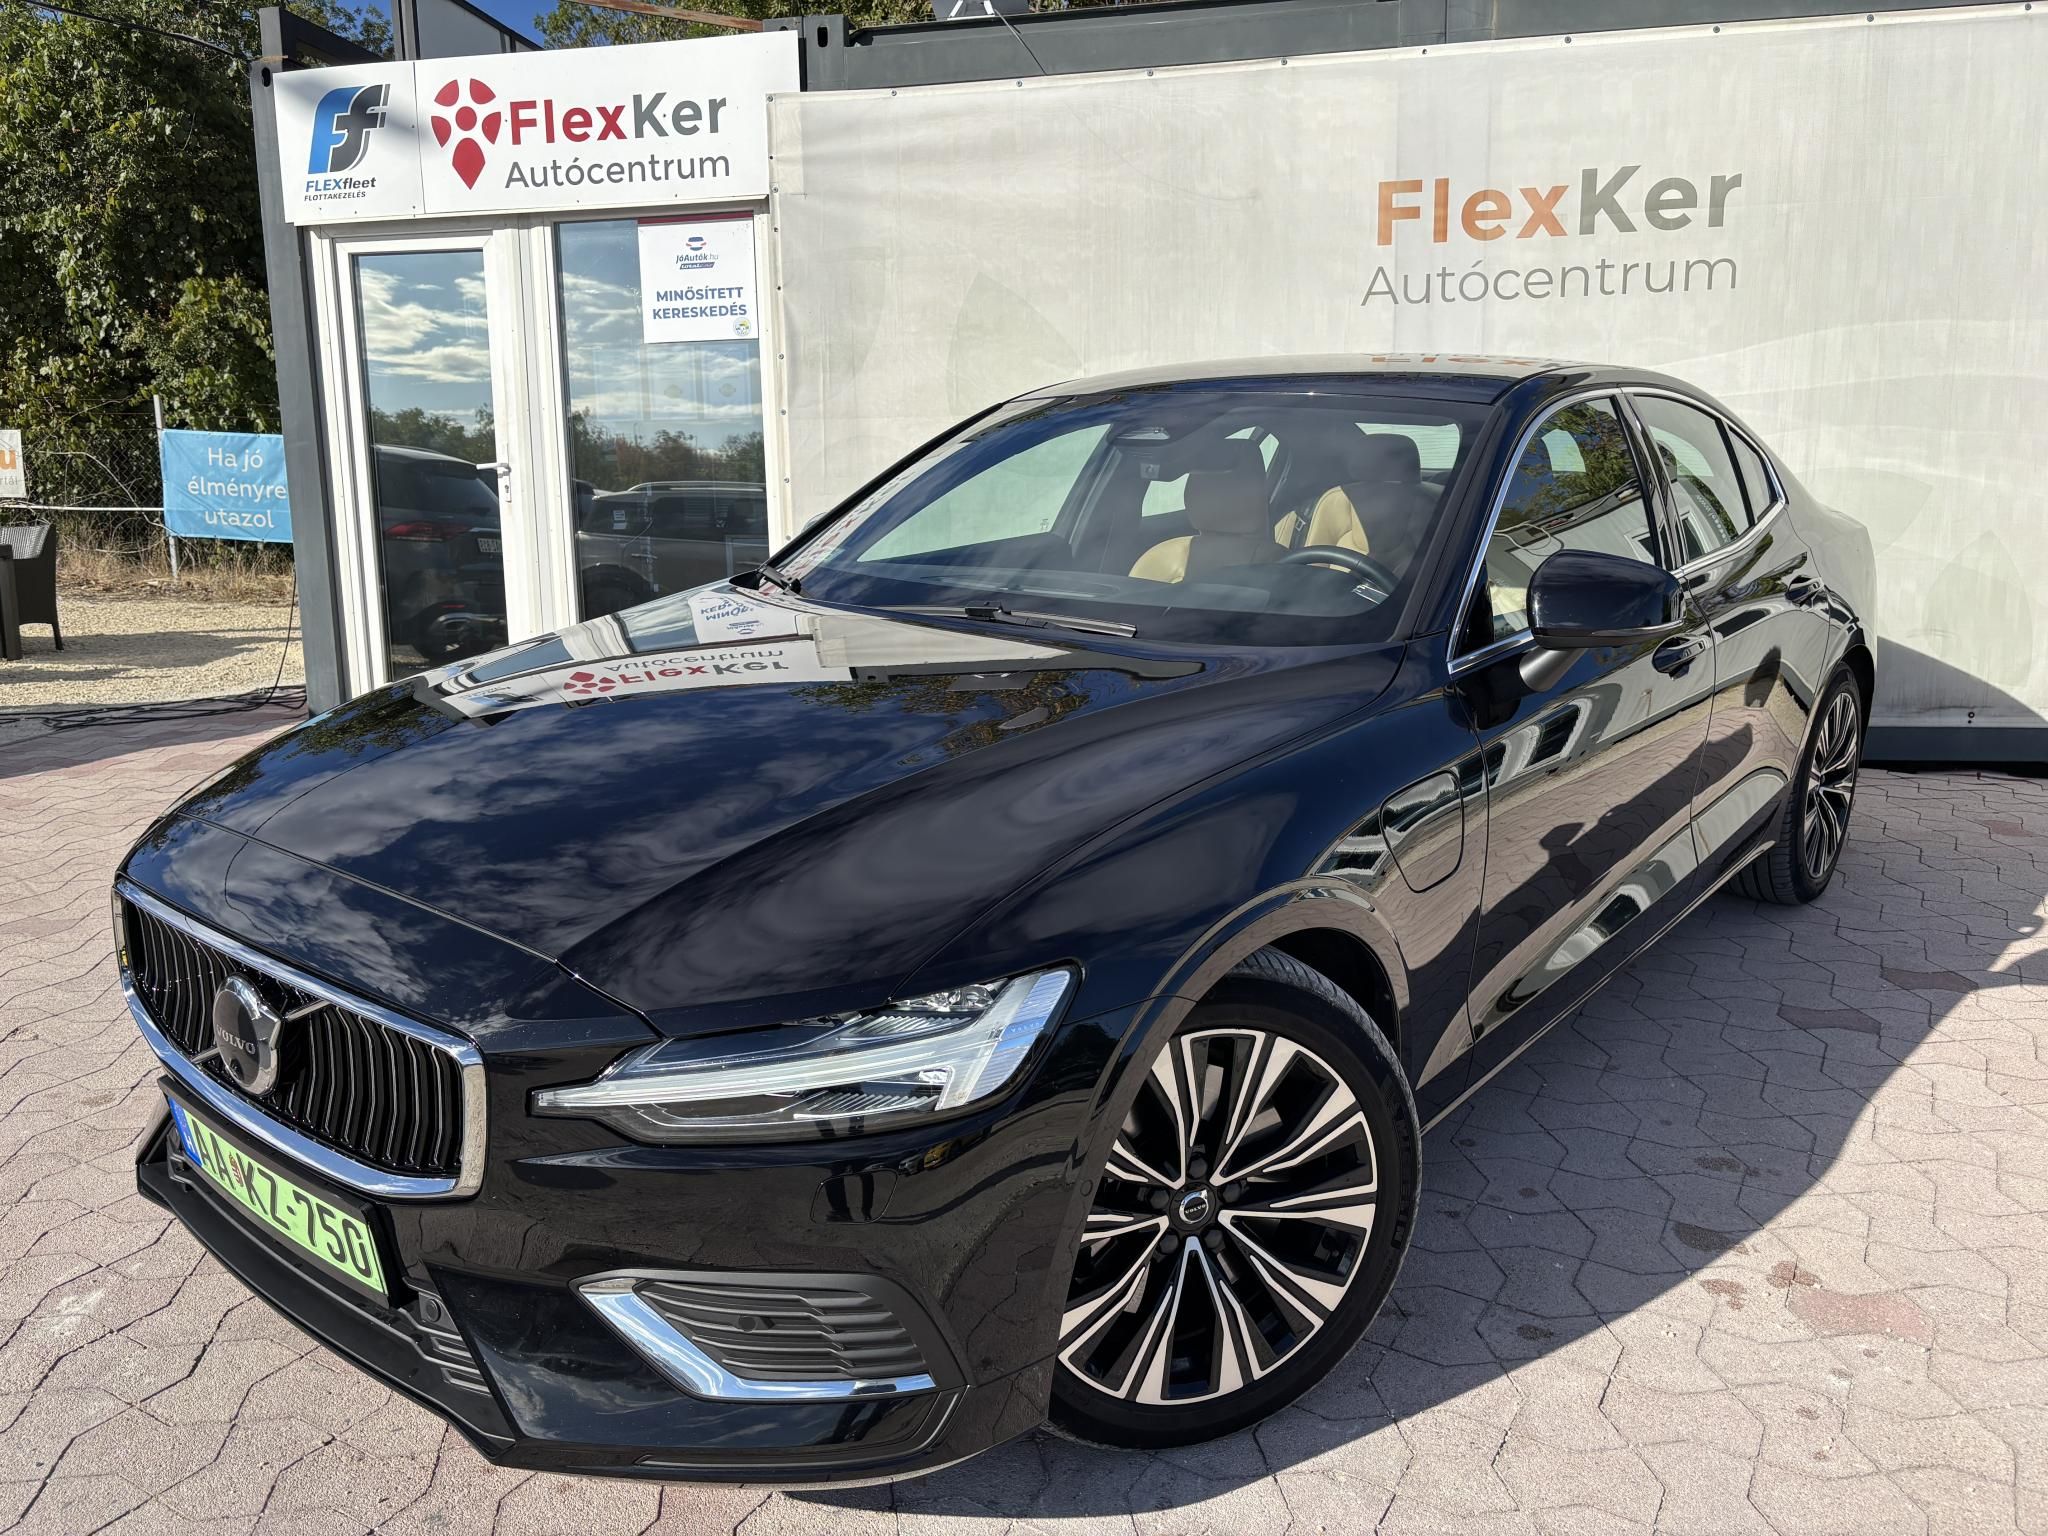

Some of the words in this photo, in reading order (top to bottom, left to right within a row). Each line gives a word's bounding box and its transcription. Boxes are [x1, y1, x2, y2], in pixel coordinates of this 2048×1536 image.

[509, 91, 727, 146] FlexKer
[505, 153, 730, 188] Autócentrum
[305, 177, 376, 192] FLEXfleet
[1377, 165, 1743, 246] FlexKer
[656, 286, 743, 302] MINŐSÍTETT
[1361, 257, 1738, 307] Autócentrum
[652, 302, 748, 320] KERESKEDÉS
[208, 448, 237, 467] Ha
[241, 448, 264, 473] jó
[187, 479, 286, 503] élményre
[204, 509, 274, 528] utazol
[216, 1023, 256, 1055] VOLVO
[1185, 1204, 1206, 1214] VOLVO
